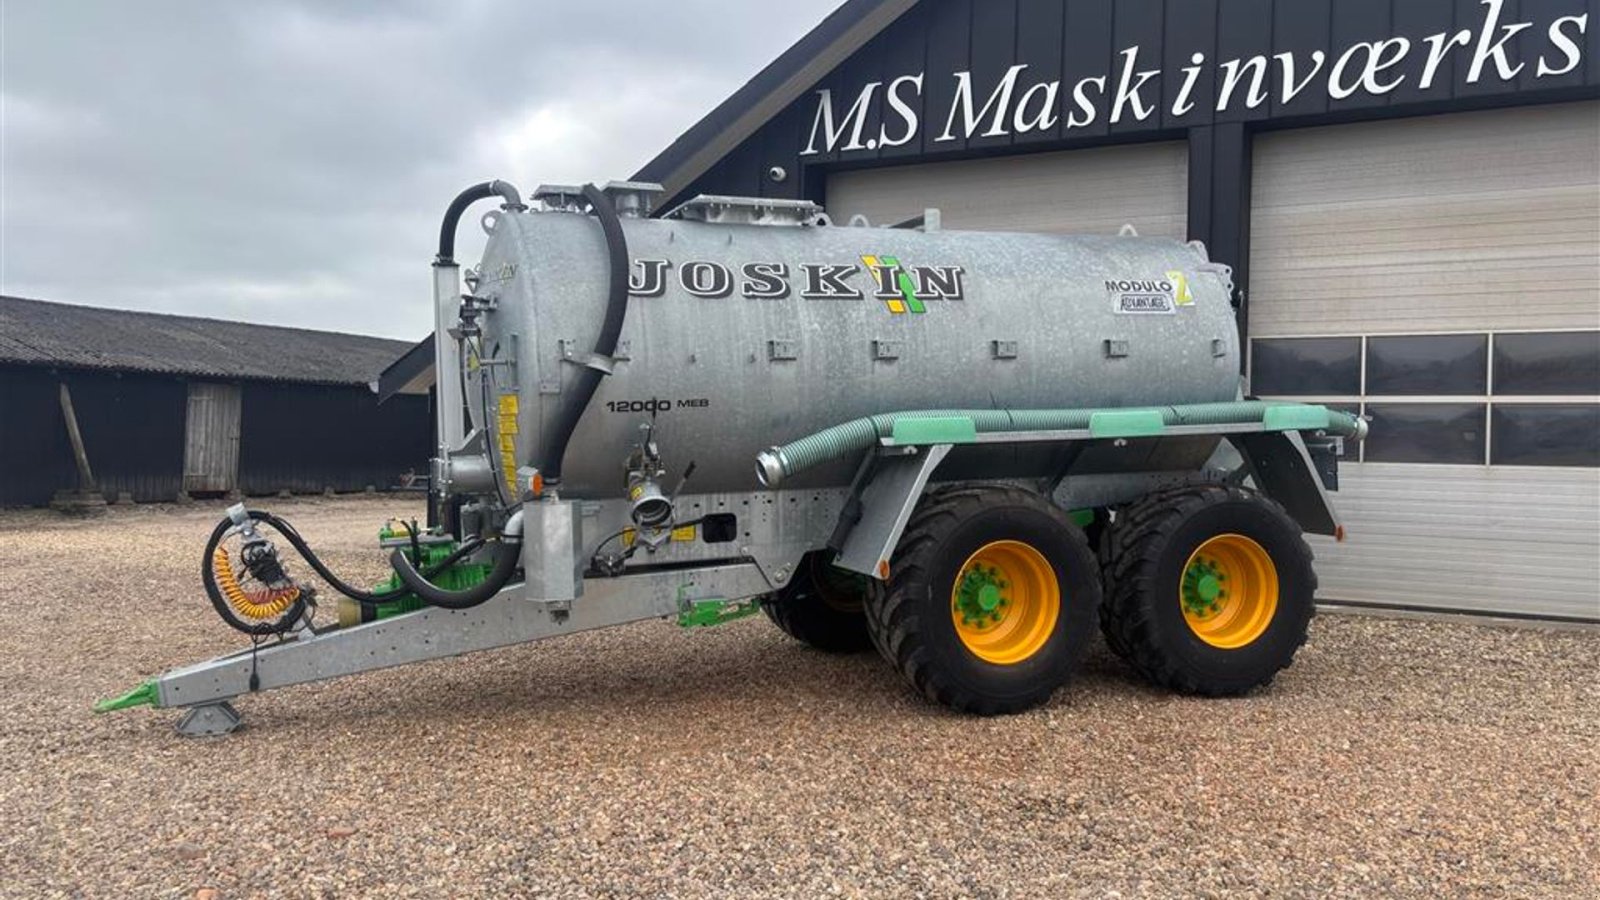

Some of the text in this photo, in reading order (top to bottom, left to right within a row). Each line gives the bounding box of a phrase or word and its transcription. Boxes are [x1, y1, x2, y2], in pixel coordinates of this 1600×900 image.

[800, 72, 924, 156] M.S
[628, 258, 965, 300] JOSKIN
[1105, 280, 1172, 292] MODULO
[606, 398, 709, 412] 12000 MEB
